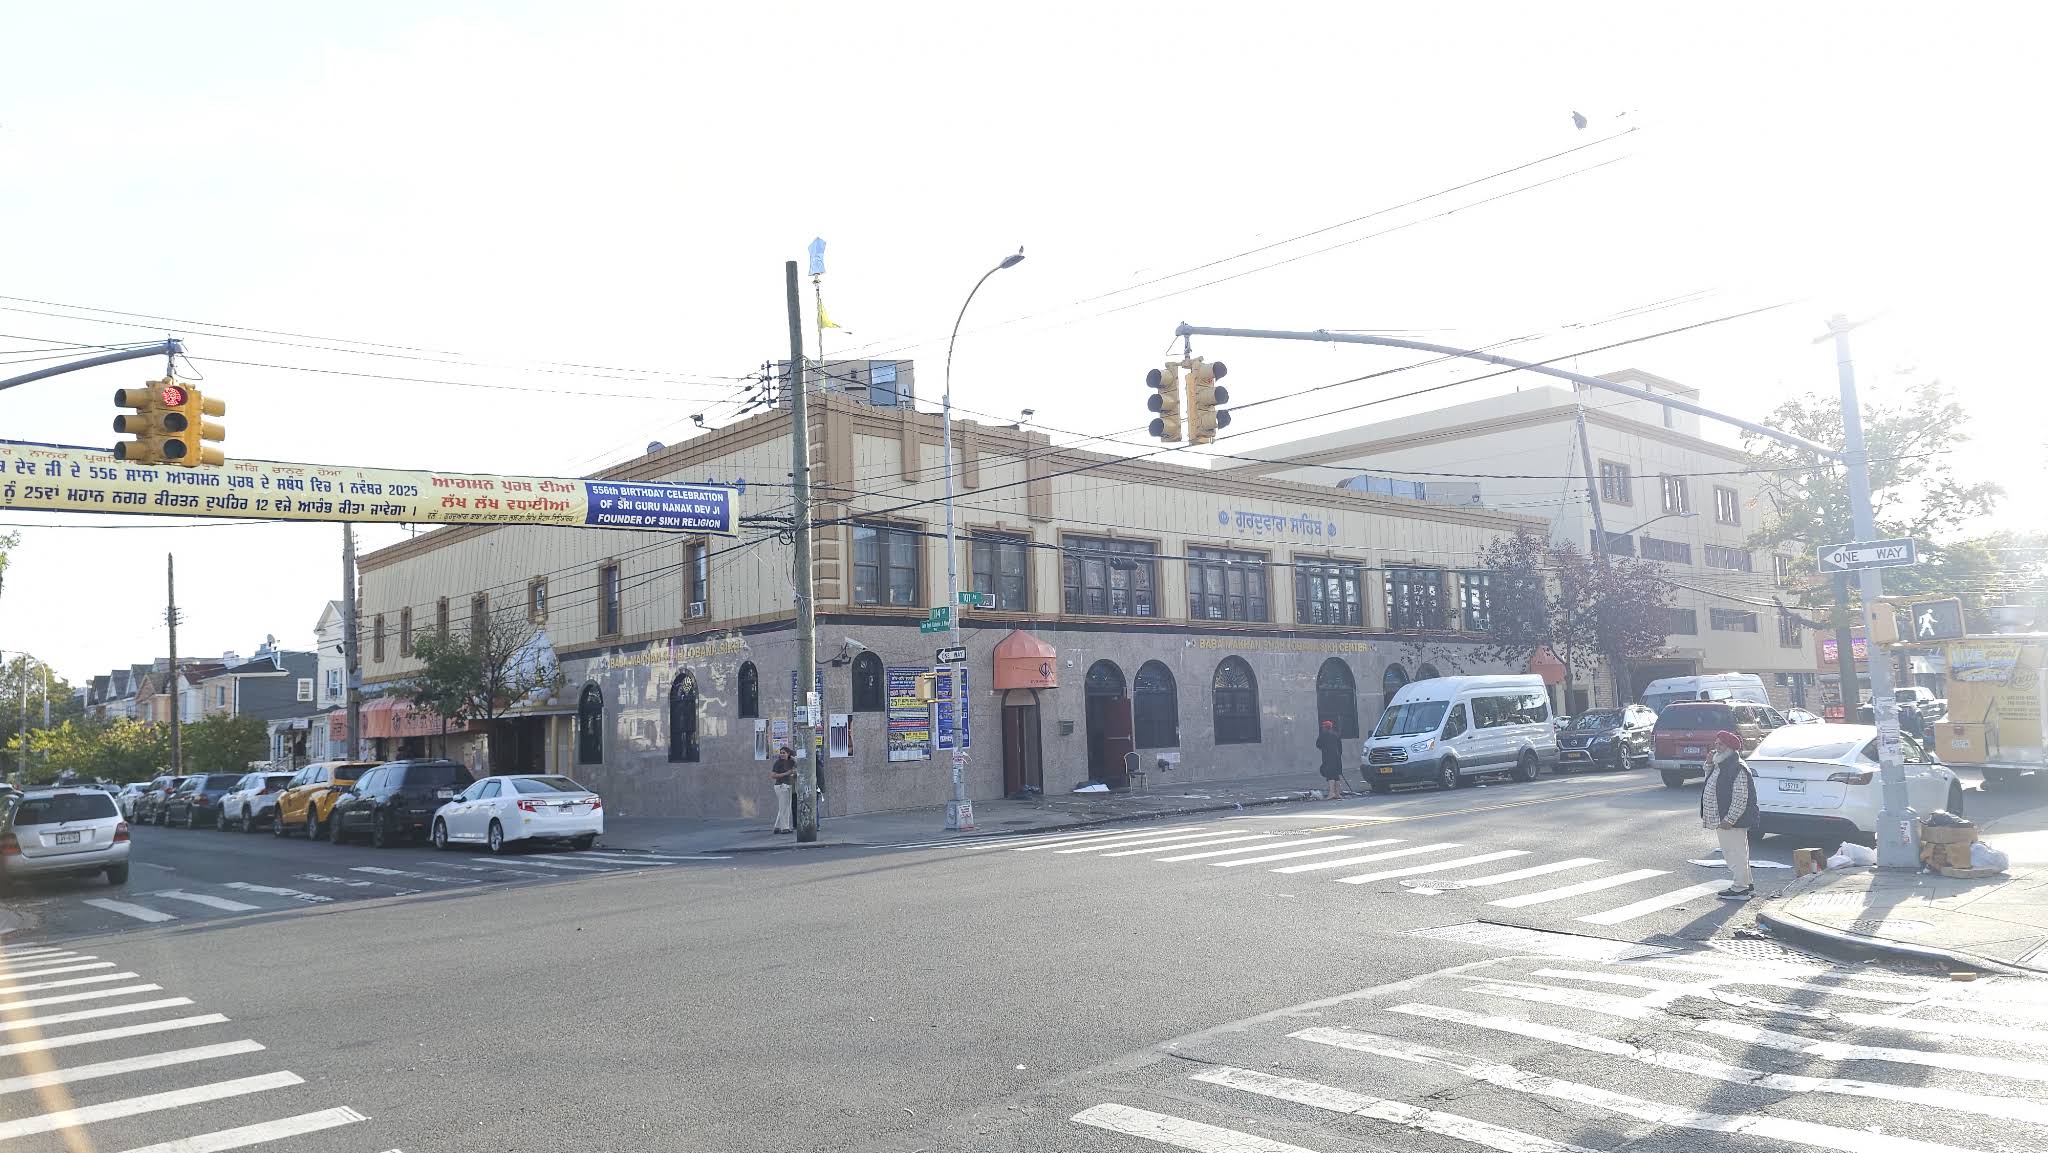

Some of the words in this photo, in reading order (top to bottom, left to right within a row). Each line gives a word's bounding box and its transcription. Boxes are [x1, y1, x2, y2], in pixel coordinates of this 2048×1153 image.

[15, 457, 36, 475] ਦੇਵ
[44, 459, 62, 477] ਜੀ
[69, 461, 81, 478] ਦੇ
[89, 467, 118, 480] 556
[125, 468, 158, 483] ਸਾਲਾ
[166, 471, 220, 487] ਆਗਮਨ
[227, 475, 255, 491] ਪੁਰਬ
[260, 473, 270, 490] ਦੇ
[310, 476, 332, 493] ਵਿਚ
[339, 482, 345, 494] 1
[350, 480, 382, 496] ਨਵੰਬਰ
[388, 484, 418, 497] 2025
[431, 477, 495, 490] ਆਗਮਨ
[500, 479, 532, 494] ਪੁਰਬ
[537, 479, 576, 494] ਦੀਆਂ
[4, 480, 16, 504] ਨੂੰ
[24, 484, 60, 500] 25ਵਾਂ
[67, 487, 105, 503] ਮਹਾਨ
[112, 490, 147, 505] ਨਗਰ
[154, 489, 199, 508] ਕੀਰਤਨ
[206, 493, 248, 512] ਦੁਪਹਿਰ
[255, 498, 269, 511] 12
[275, 495, 292, 512] ਵਜੇ
[298, 497, 333, 514] ਆਰੰਭ
[338, 499, 365, 515] ਕੀਤਾ
[370, 500, 406, 516] ਜਾਵੇਗਾ
[441, 493, 467, 509] ਲੱਖ
[474, 495, 499, 510] ਲੱਖ
[506, 497, 570, 512] ਵਧਾਈਆਂ
[592, 485, 619, 496] 556th
[620, 487, 665, 499] BIRTHDAY
[666, 490, 724, 502] CELEBRATION
[600, 499, 613, 509] OF
[617, 500, 632, 510] SRI
[634, 501, 660, 512] GURU
[662, 502, 693, 513] NANAK
[694, 504, 711, 515] DEV
[712, 506, 720, 515] JI
[597, 513, 642, 525] FOUNDER
[644, 516, 657, 525] OF
[658, 517, 680, 527] SIKH
[681, 518, 721, 529] RELIGION
[1290, 512, 1322, 536] ਸਾਹਿਬ
[1833, 551, 1859, 564] ONE
[1876, 546, 1904, 559] WAY
